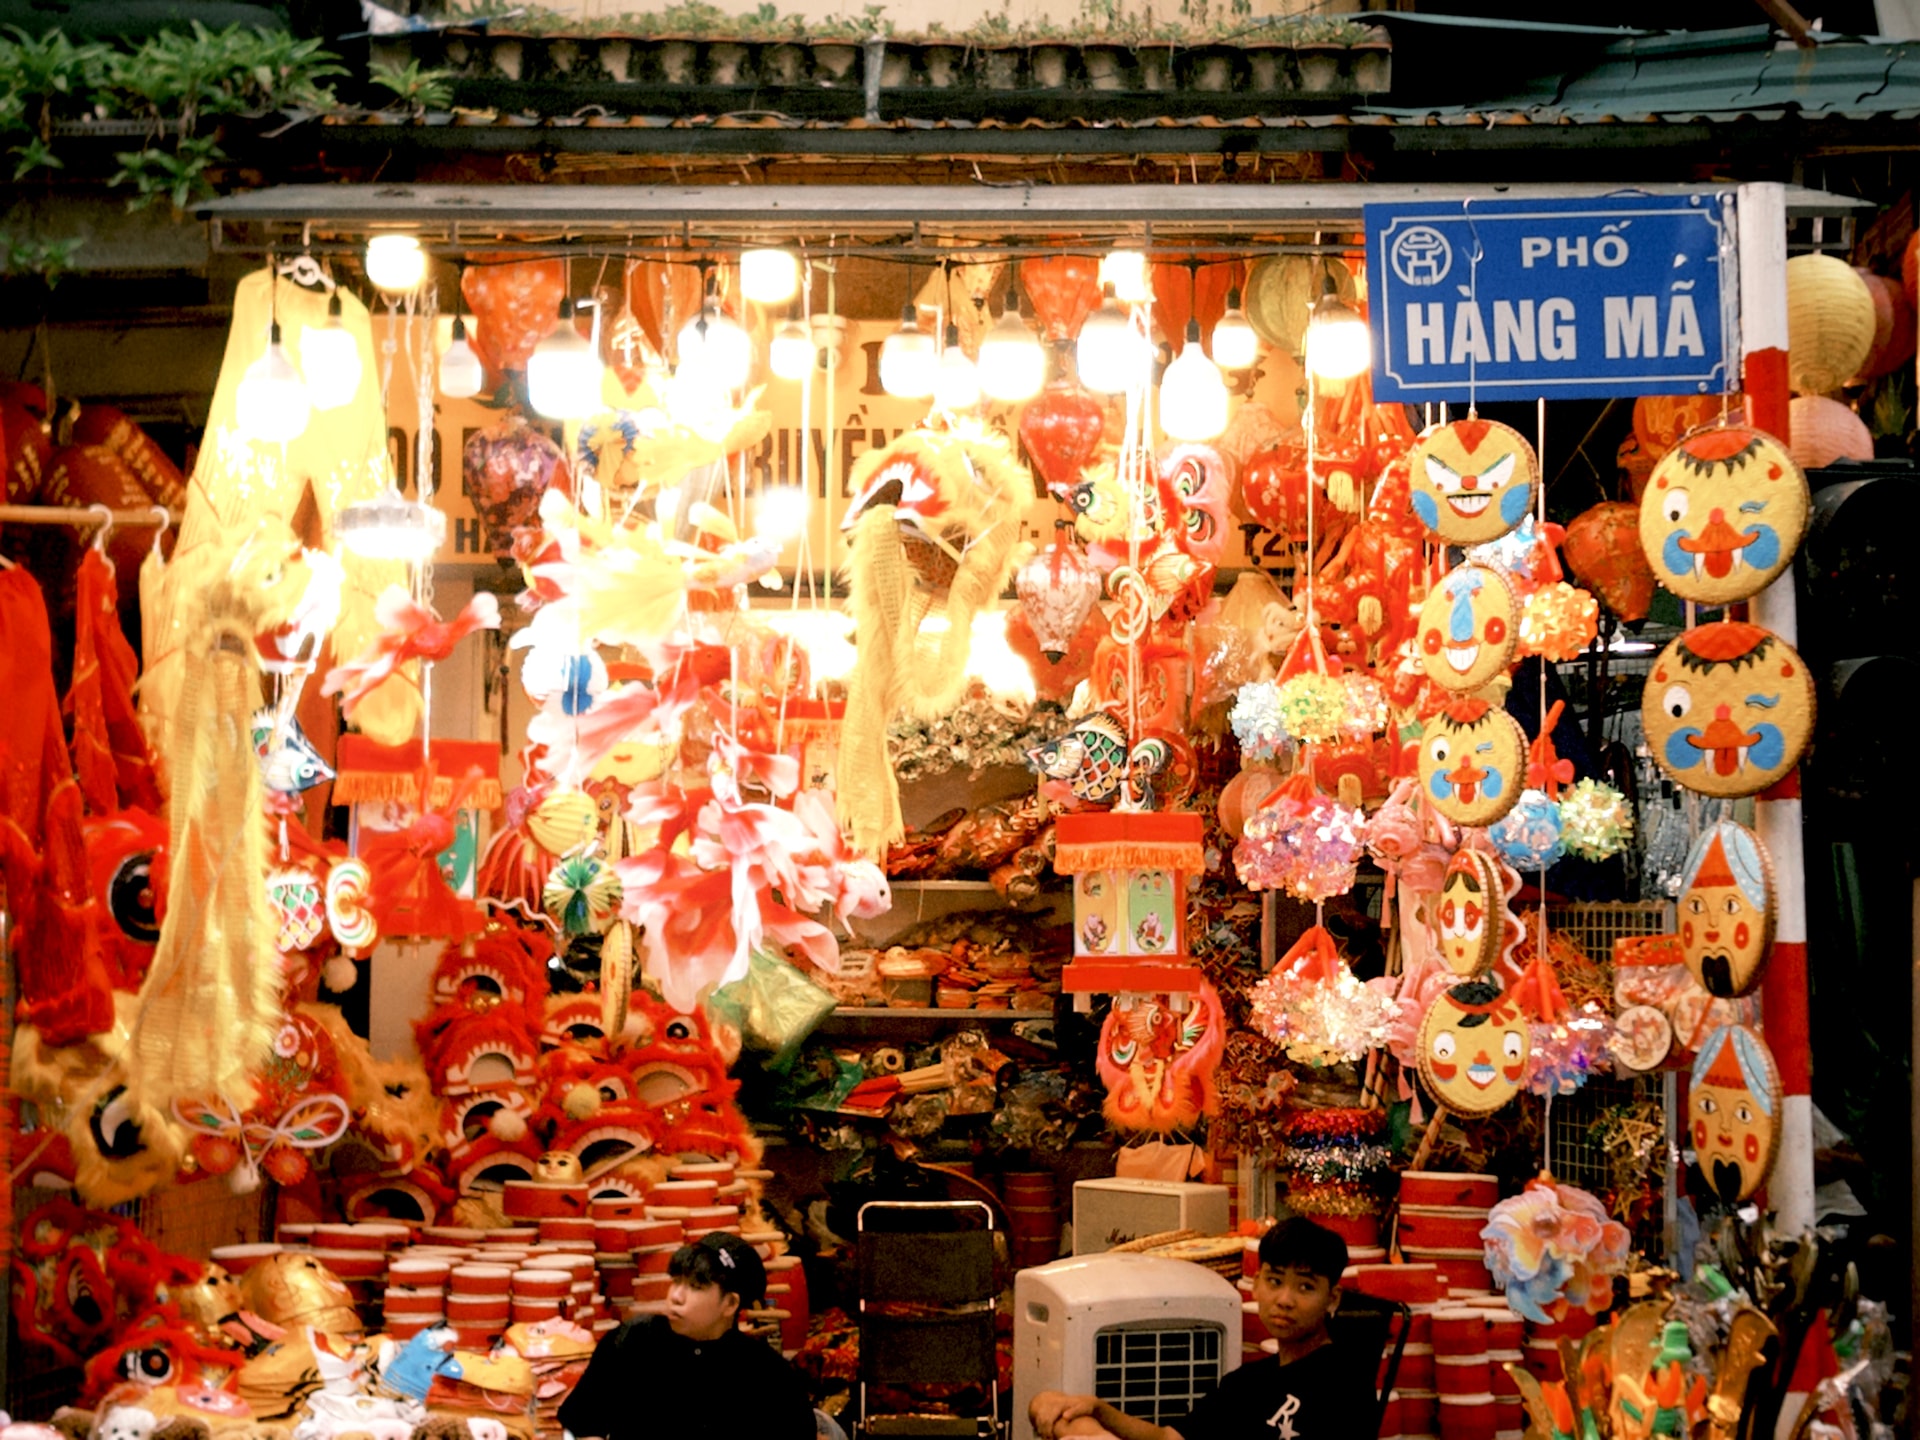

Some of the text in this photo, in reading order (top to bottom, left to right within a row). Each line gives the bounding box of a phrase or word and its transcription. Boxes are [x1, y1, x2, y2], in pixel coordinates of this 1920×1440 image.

[1520, 220, 1632, 269] PHỐ
[1405, 279, 1706, 366] HÀNG MÃ
